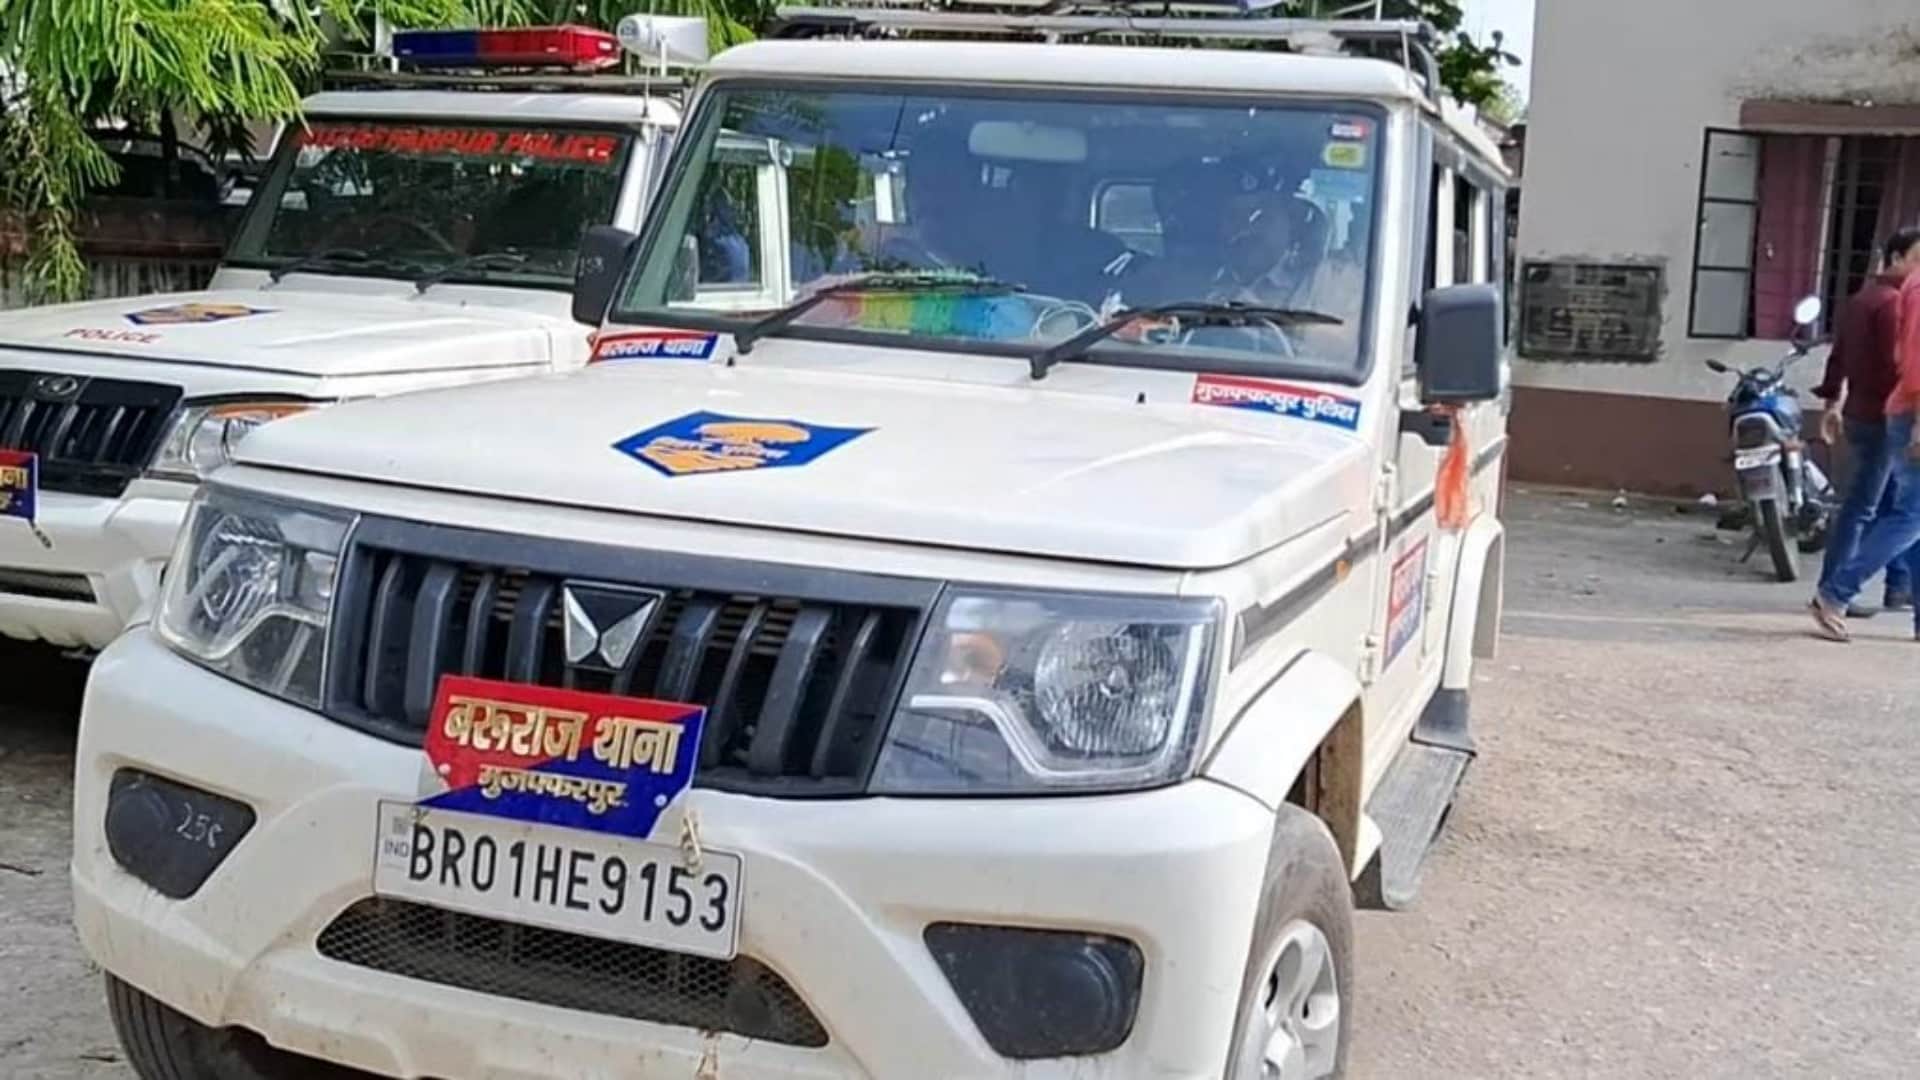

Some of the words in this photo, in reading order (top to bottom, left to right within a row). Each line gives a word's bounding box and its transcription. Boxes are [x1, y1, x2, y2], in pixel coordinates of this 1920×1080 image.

[503, 133, 616, 161] POLICE
[64, 328, 162, 343] POLICE
[593, 716, 685, 775] थाना
[409, 822, 730, 932] BR01HE9153
